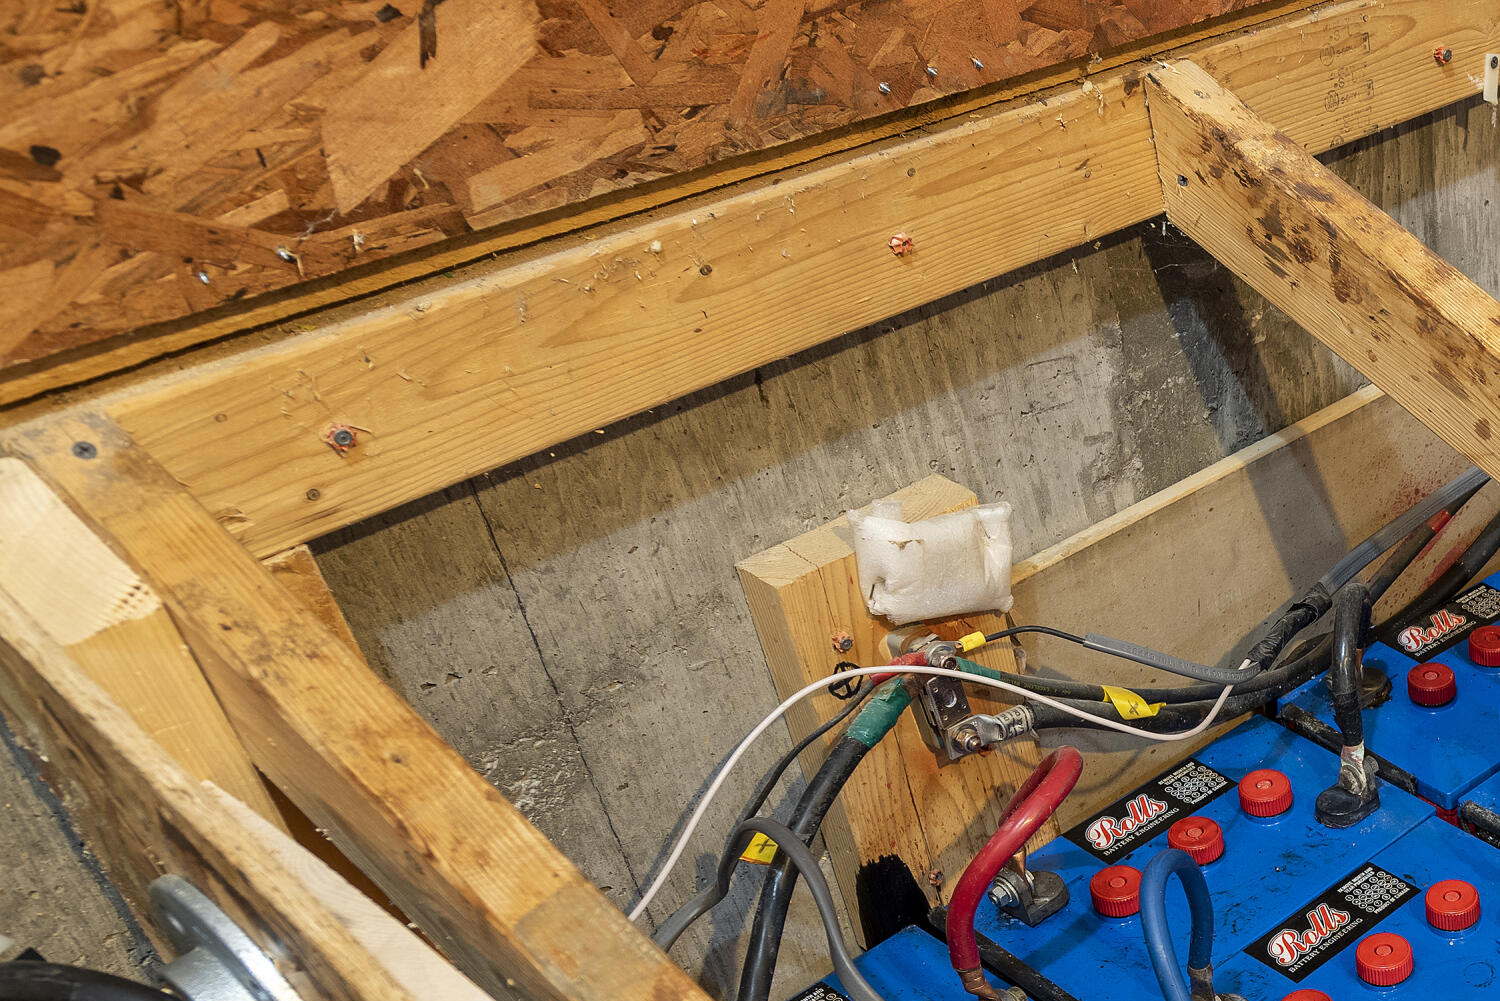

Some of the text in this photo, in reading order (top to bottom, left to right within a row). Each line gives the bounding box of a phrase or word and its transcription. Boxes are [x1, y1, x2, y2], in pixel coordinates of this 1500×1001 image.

[1398, 610, 1466, 651] Rolls
[1085, 794, 1168, 849] Rolls
[1104, 808, 1179, 855] BATTERY ENGINEERING
[1268, 903, 1350, 966] Rolls
[1289, 918, 1362, 972] BATTERY ENGINEERING
